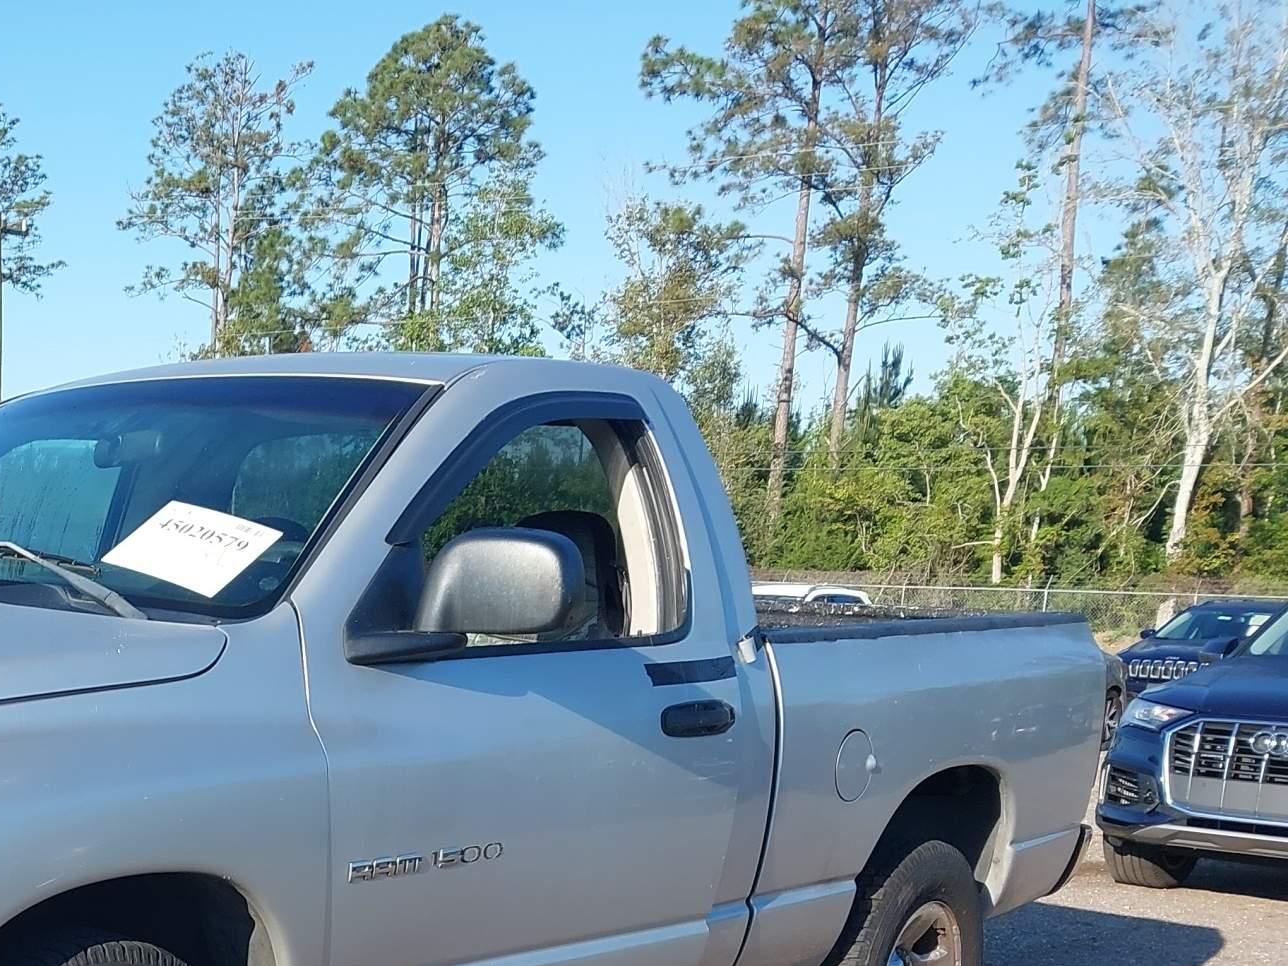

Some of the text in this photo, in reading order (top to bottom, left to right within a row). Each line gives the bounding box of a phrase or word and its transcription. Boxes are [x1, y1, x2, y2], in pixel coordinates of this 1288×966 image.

[159, 518, 250, 551] 45020579
[347, 842, 504, 884] RAM 1500
